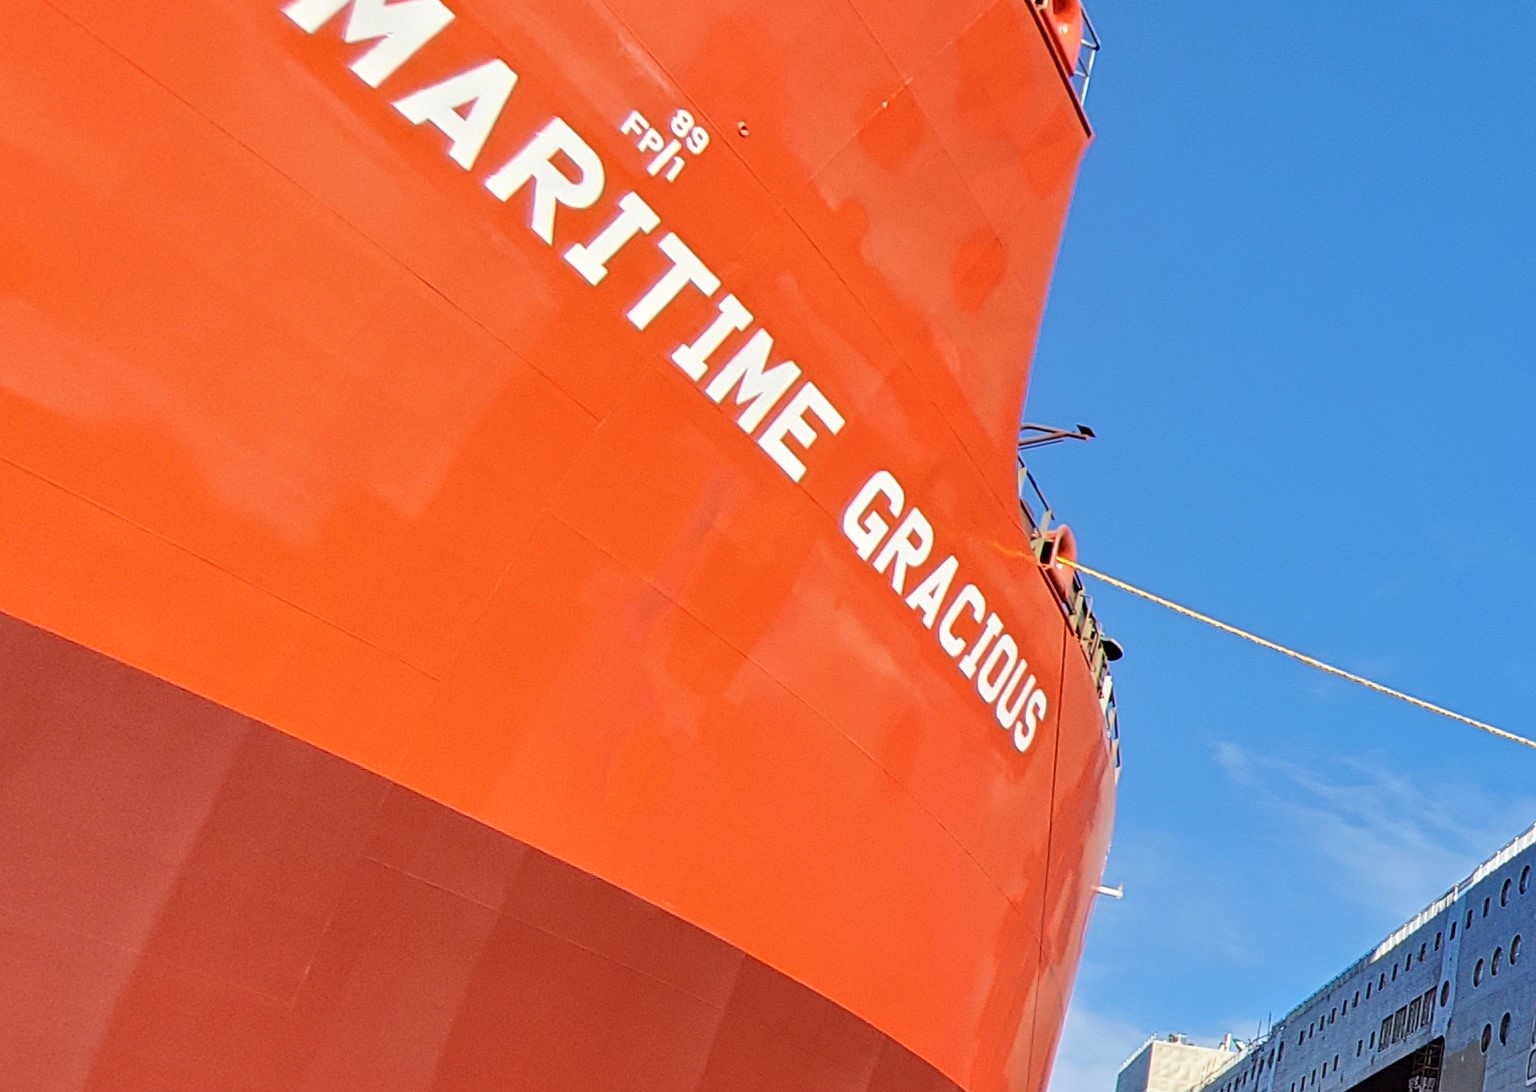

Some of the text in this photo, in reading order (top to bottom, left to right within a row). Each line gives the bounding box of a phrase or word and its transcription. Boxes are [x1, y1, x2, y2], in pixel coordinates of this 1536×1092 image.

[669, 108, 710, 156] 89
[280, 0, 1048, 752] MARITIME GRACIOUS
